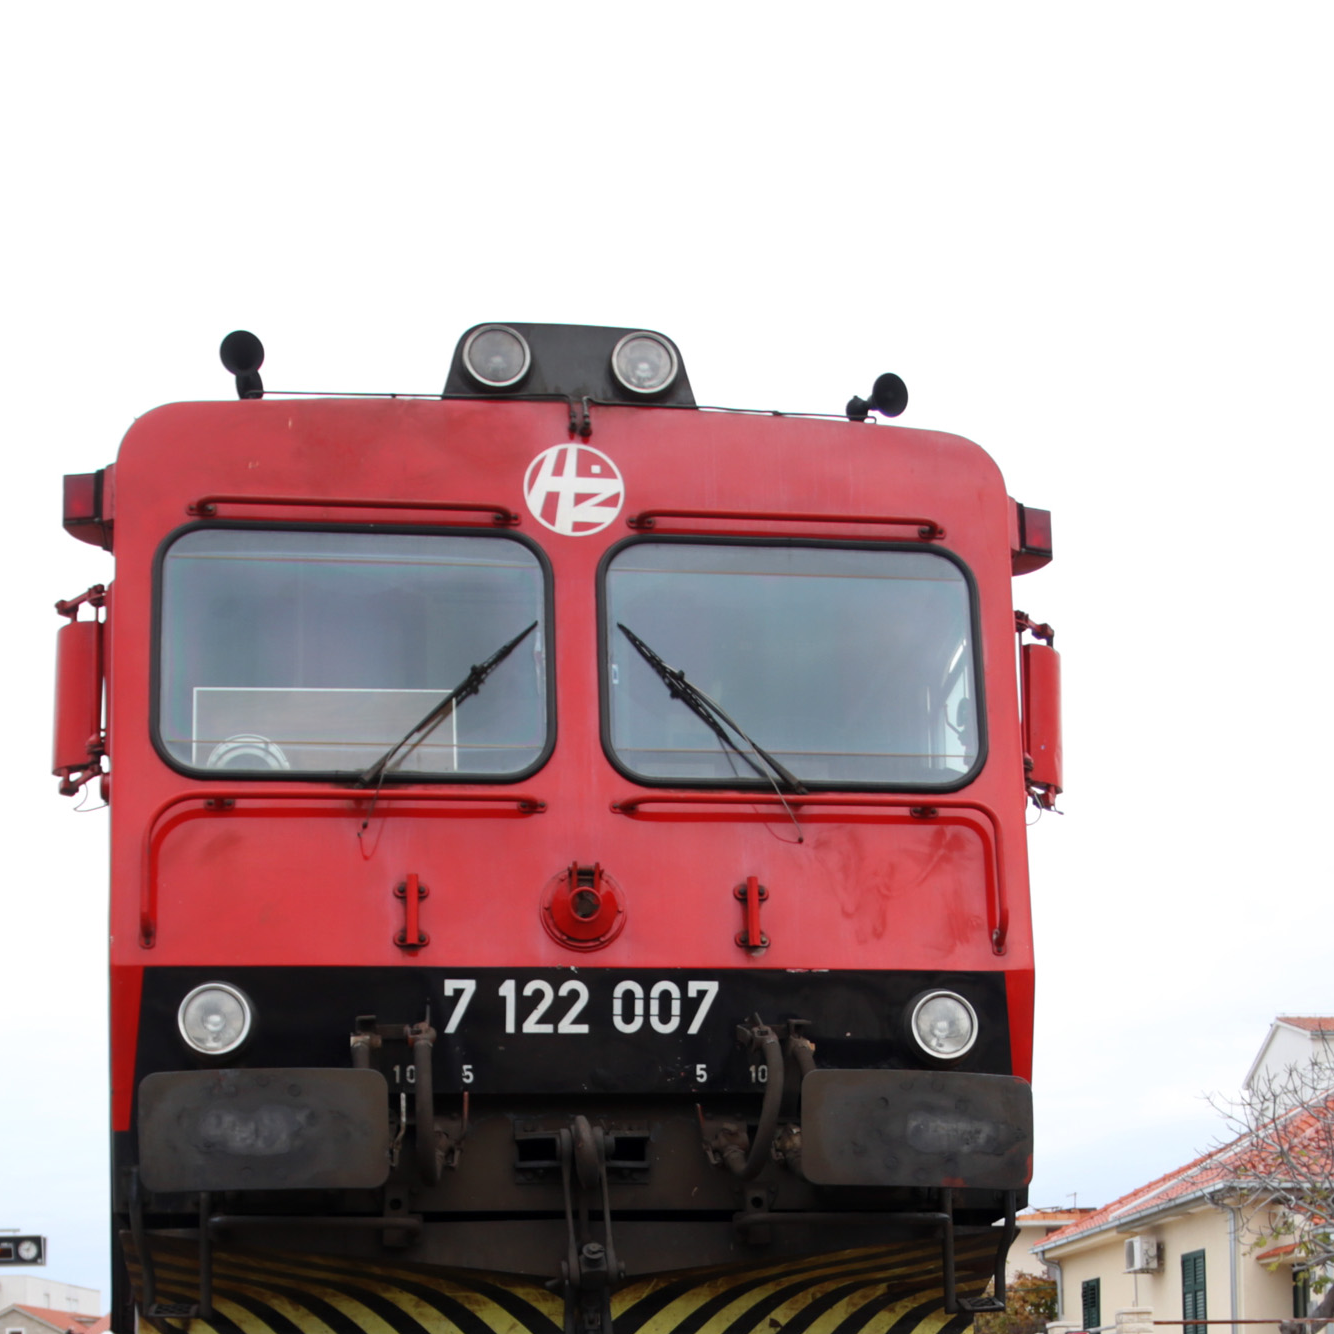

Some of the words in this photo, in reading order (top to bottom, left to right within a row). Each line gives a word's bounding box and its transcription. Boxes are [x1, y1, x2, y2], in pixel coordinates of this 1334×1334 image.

[444, 979, 476, 1034] 7
[498, 979, 590, 1034] 122
[612, 980, 720, 1035] 007
[393, 1065, 416, 1084] 10
[462, 1065, 474, 1084] 5
[696, 1064, 708, 1083] 5
[749, 1065, 768, 1084] 10
